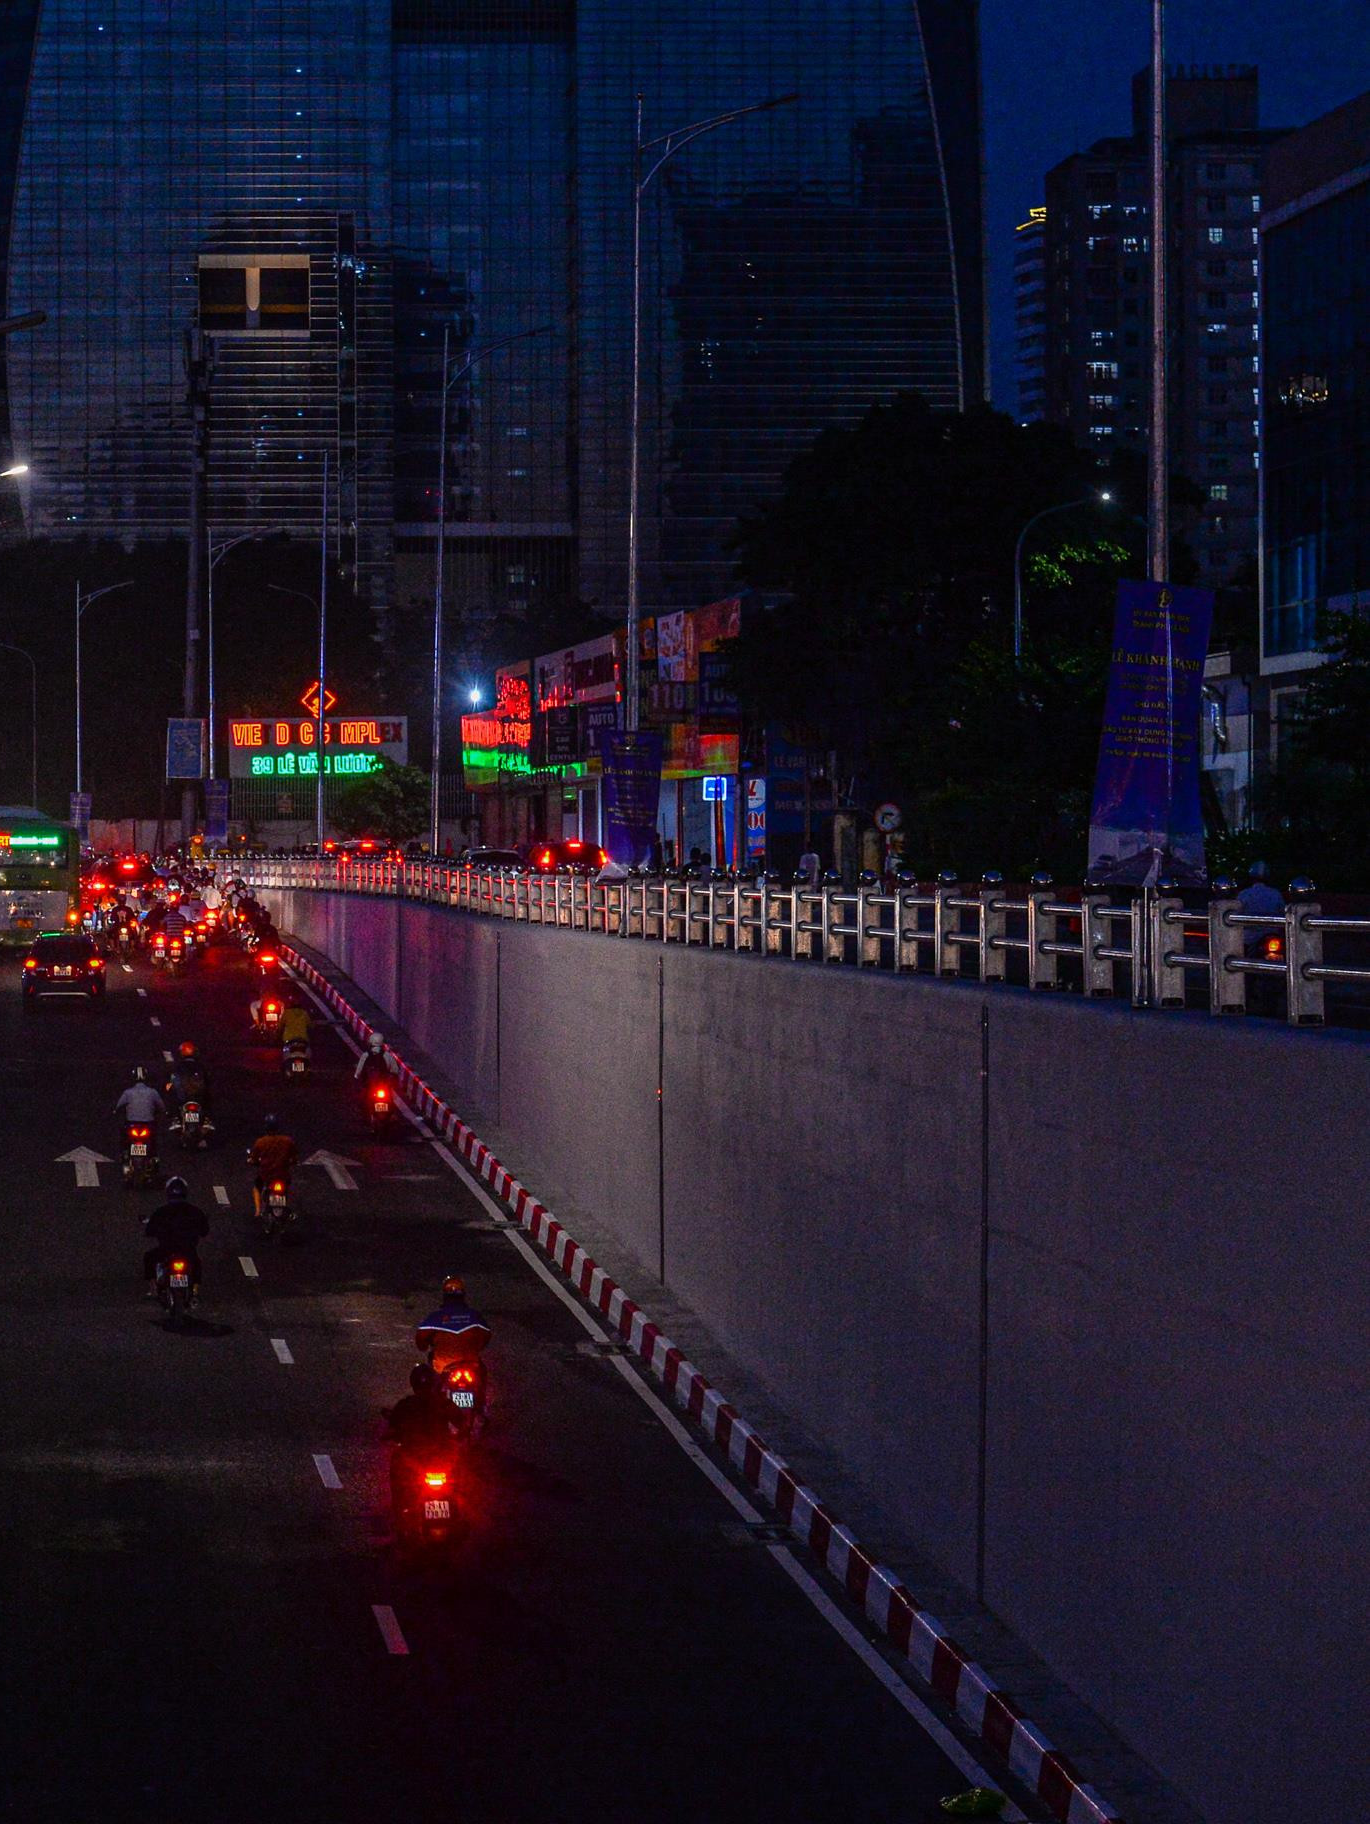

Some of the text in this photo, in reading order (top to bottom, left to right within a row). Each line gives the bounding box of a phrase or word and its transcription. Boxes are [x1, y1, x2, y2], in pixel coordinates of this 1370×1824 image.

[589, 713, 614, 726] AUTO
[252, 756, 274, 775] 39
[277, 752, 296, 774] LÊ
